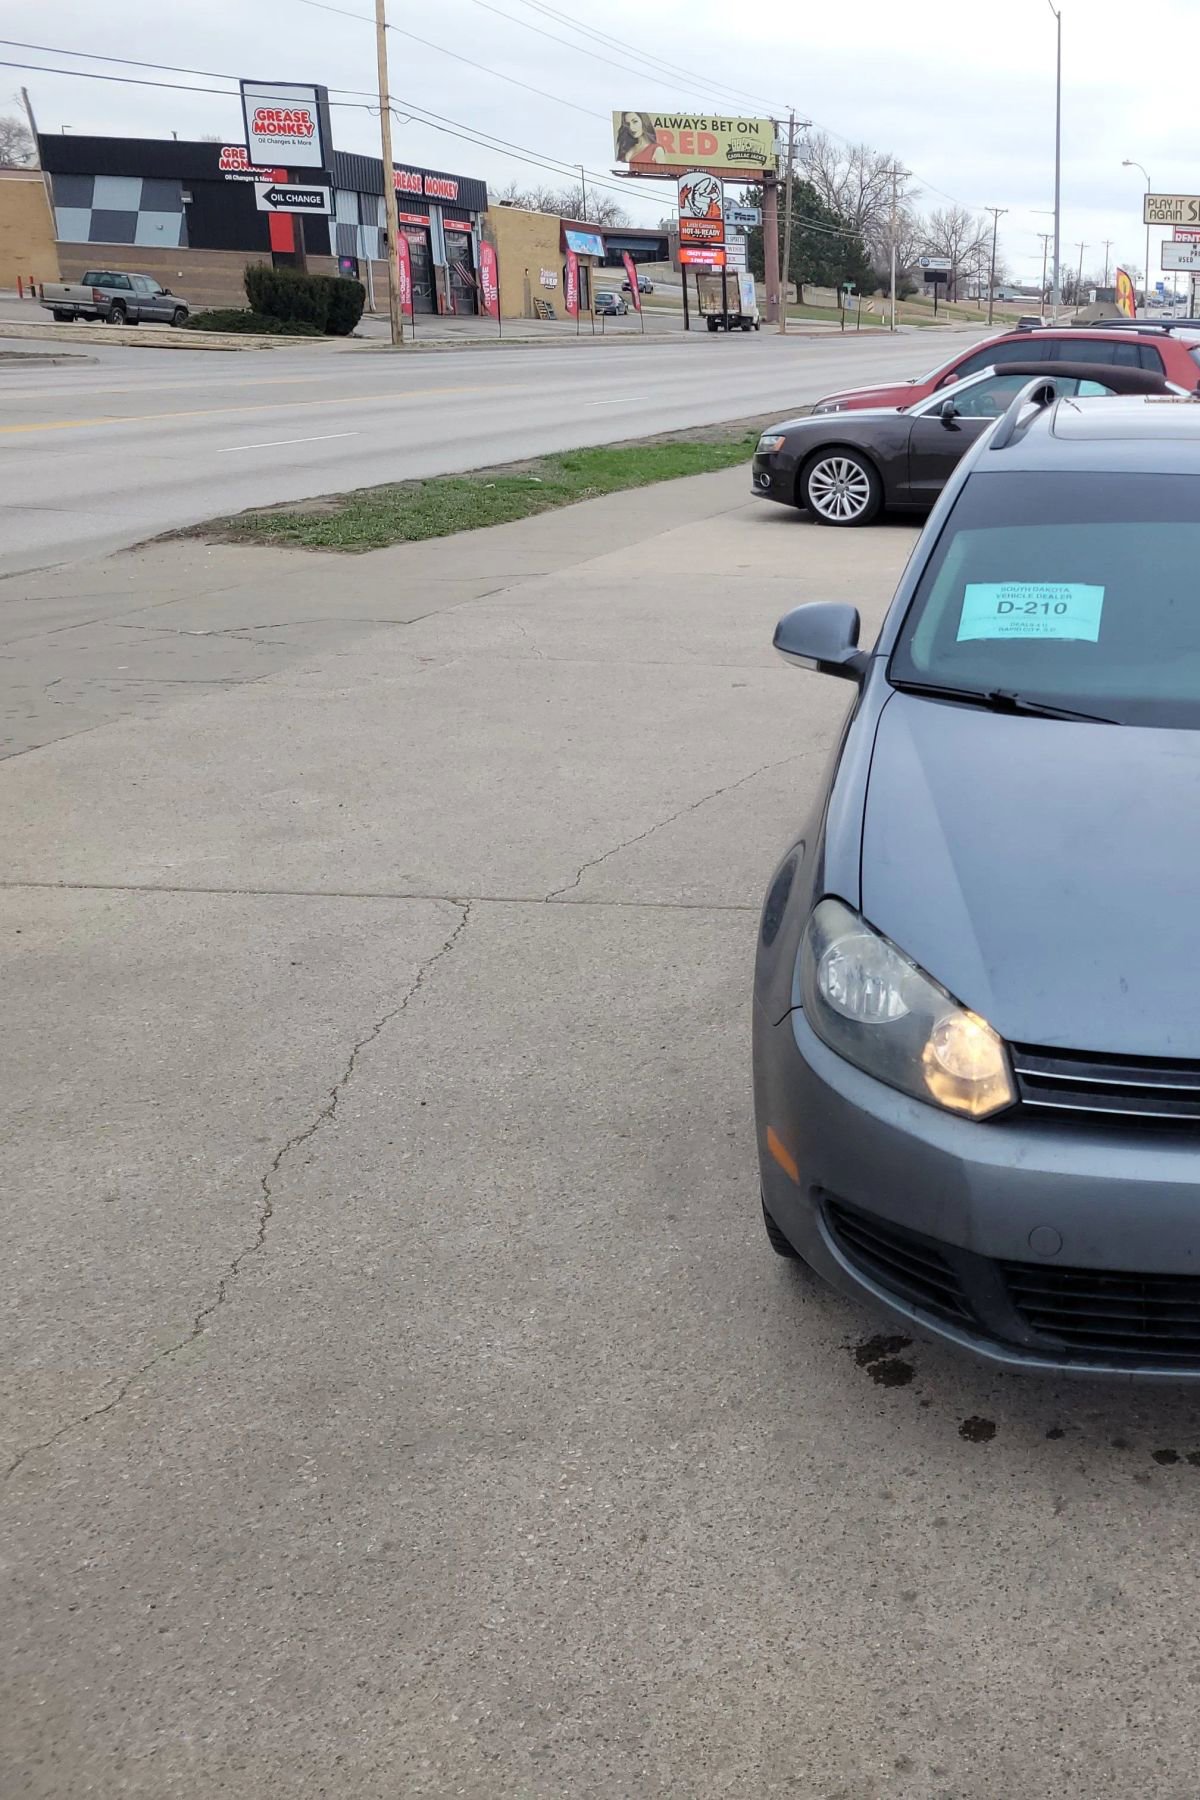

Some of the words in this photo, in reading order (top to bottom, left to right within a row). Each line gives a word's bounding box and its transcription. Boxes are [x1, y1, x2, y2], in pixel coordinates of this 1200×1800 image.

[255, 108, 310, 123] GREASE
[254, 122, 314, 136] MONKEY
[654, 117, 708, 131] ALWAYS
[711, 120, 734, 132] BET
[736, 122, 759, 134] ON
[267, 138, 291, 146] Changes
[656, 130, 718, 156] RED
[222, 148, 247, 160] GRE
[425, 176, 458, 200] MONKEY
[270, 194, 284, 202] OIL
[286, 194, 322, 204] CHANGE
[1148, 198, 1173, 209] PLAY
[1175, 200, 1184, 209] IT
[1150, 210, 1183, 220] AGAIN
[682, 228, 720, 236] HOT-N-READY
[996, 601, 1068, 615] D-210
